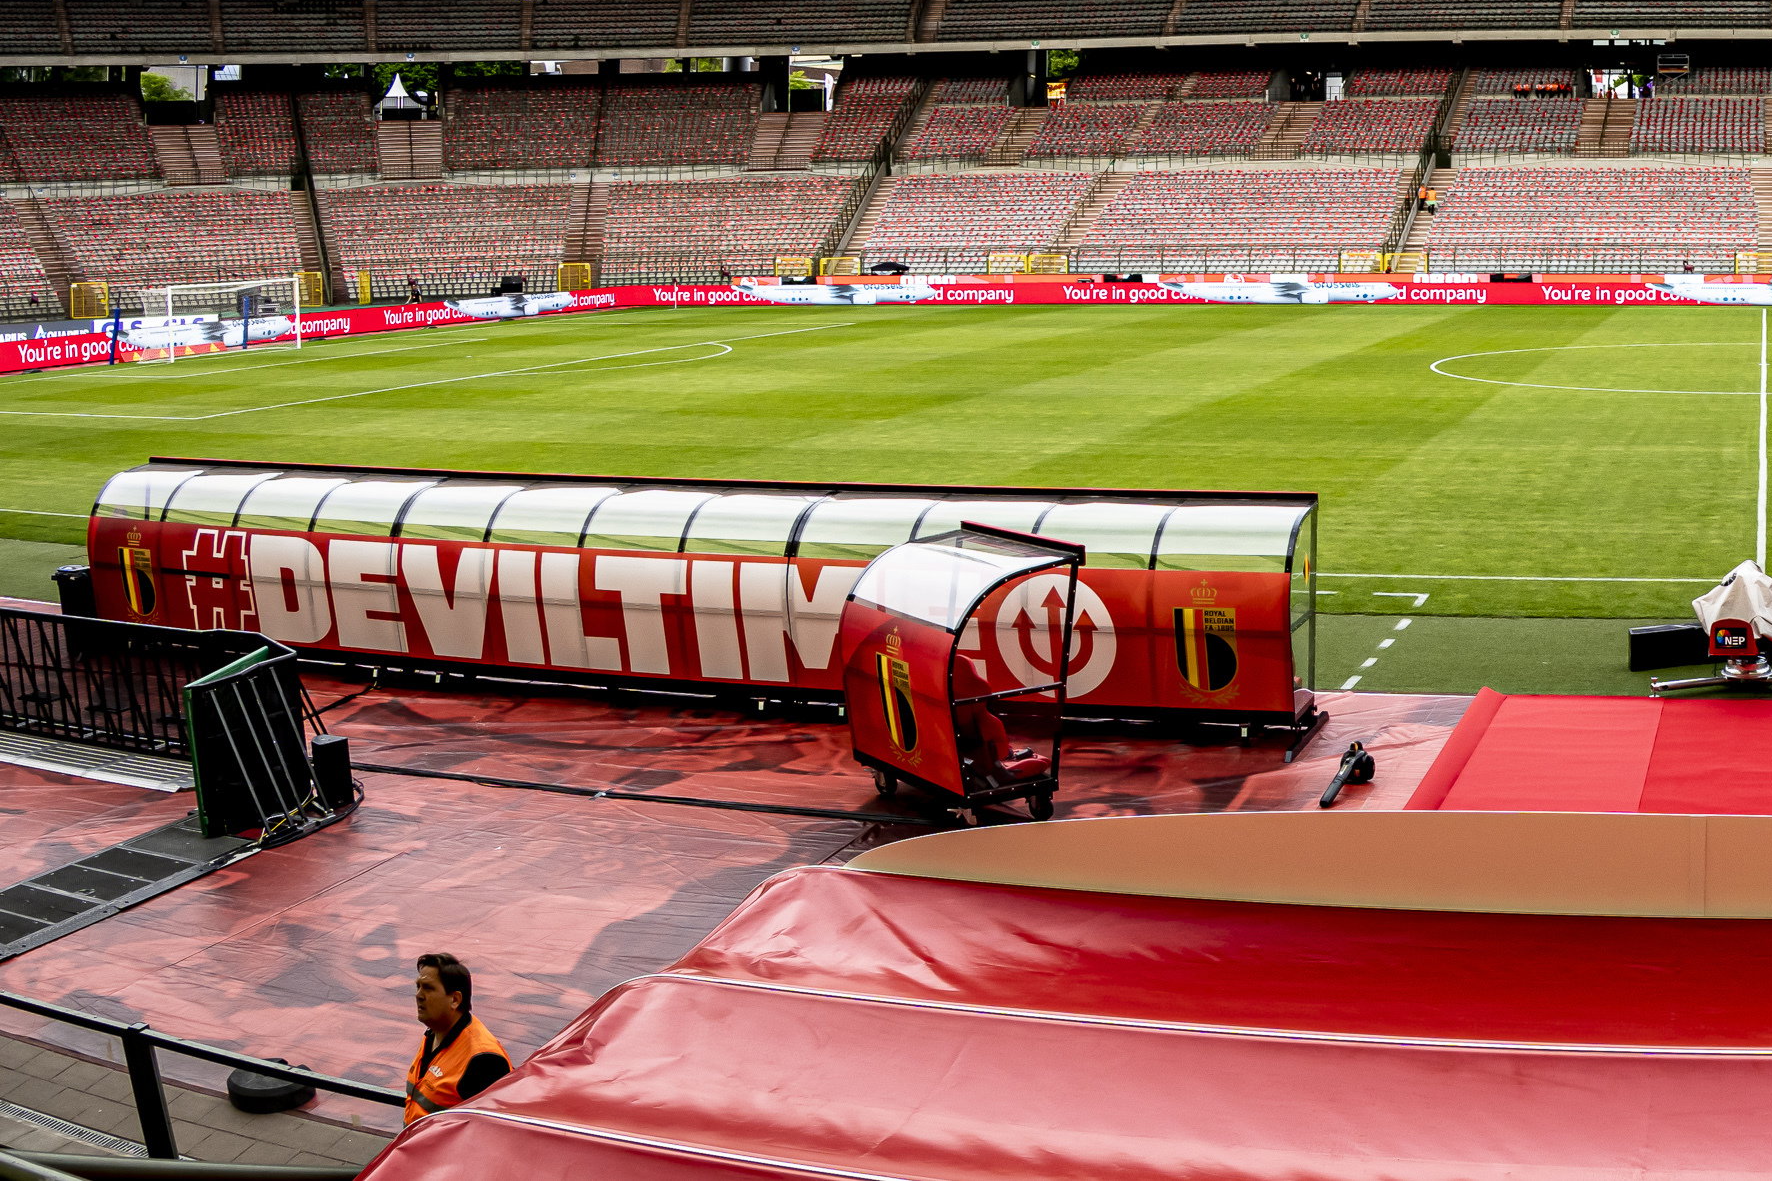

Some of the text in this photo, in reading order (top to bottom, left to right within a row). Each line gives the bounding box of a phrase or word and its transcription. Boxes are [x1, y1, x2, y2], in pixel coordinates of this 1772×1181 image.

[579, 293, 615, 307] company
[694, 289, 705, 301] in
[708, 289, 740, 304] good
[947, 289, 1014, 303] company
[1063, 284, 1108, 300] You're
[1112, 286, 1126, 300] in
[1129, 286, 1168, 303] good
[1410, 288, 1487, 303] company
[1541, 284, 1591, 300] You're
[1595, 286, 1610, 301] in
[1614, 286, 1656, 304] good
[384, 307, 413, 325] You're
[415, 308, 425, 322] in
[426, 307, 450, 325] good
[300, 317, 350, 334] company
[18, 340, 62, 364] You're
[65, 340, 78, 359] in
[1724, 636, 1746, 646] NEP
